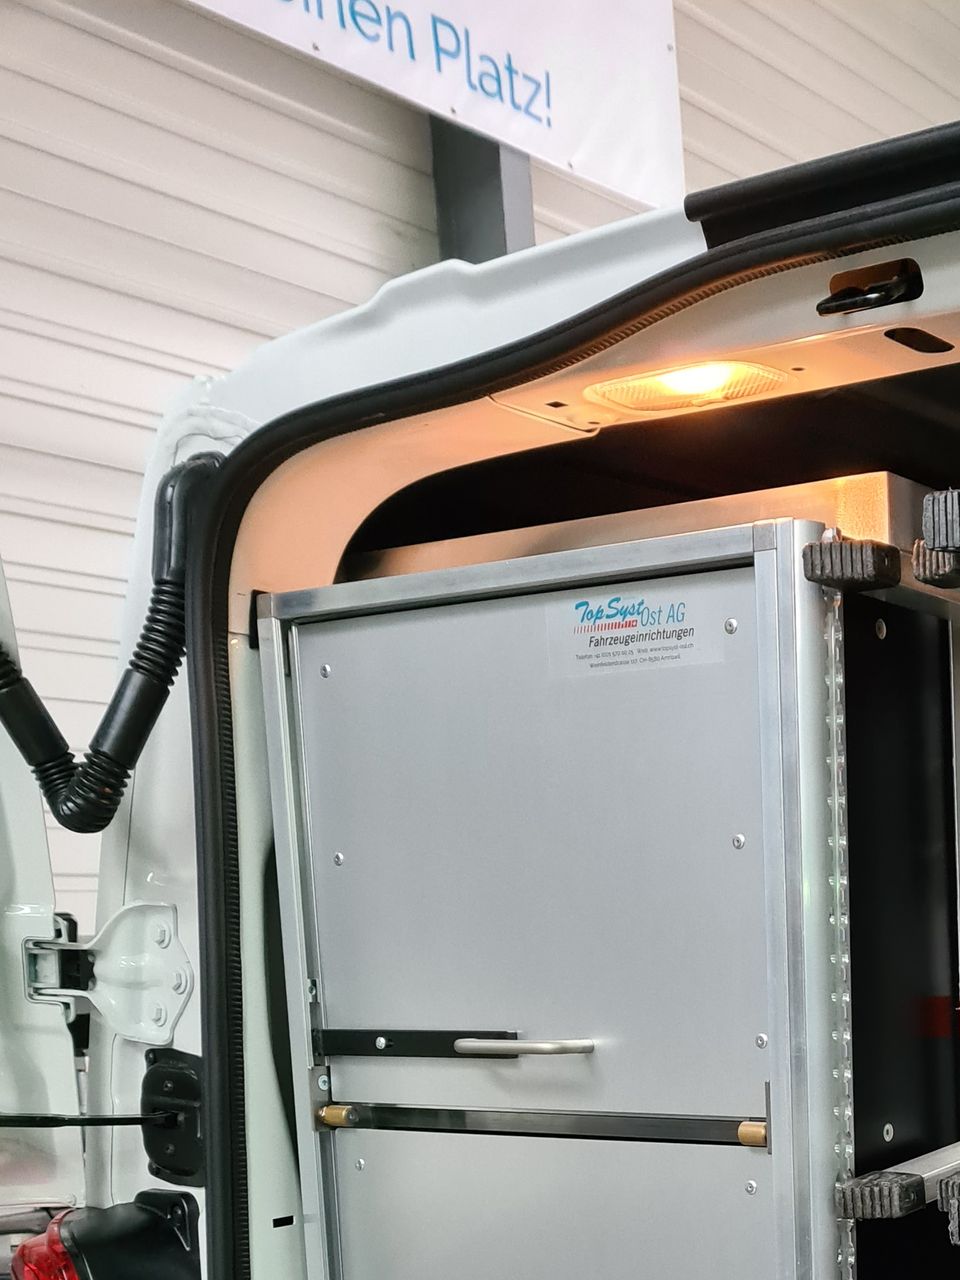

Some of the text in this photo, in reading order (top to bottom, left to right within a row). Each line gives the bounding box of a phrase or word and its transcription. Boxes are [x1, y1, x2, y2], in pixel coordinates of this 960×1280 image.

[430, 14, 552, 128] Platz!
[640, 606, 662, 627] Ost
[665, 602, 686, 624] AG
[588, 627, 695, 648] Fahrzeugeinrichtungen
